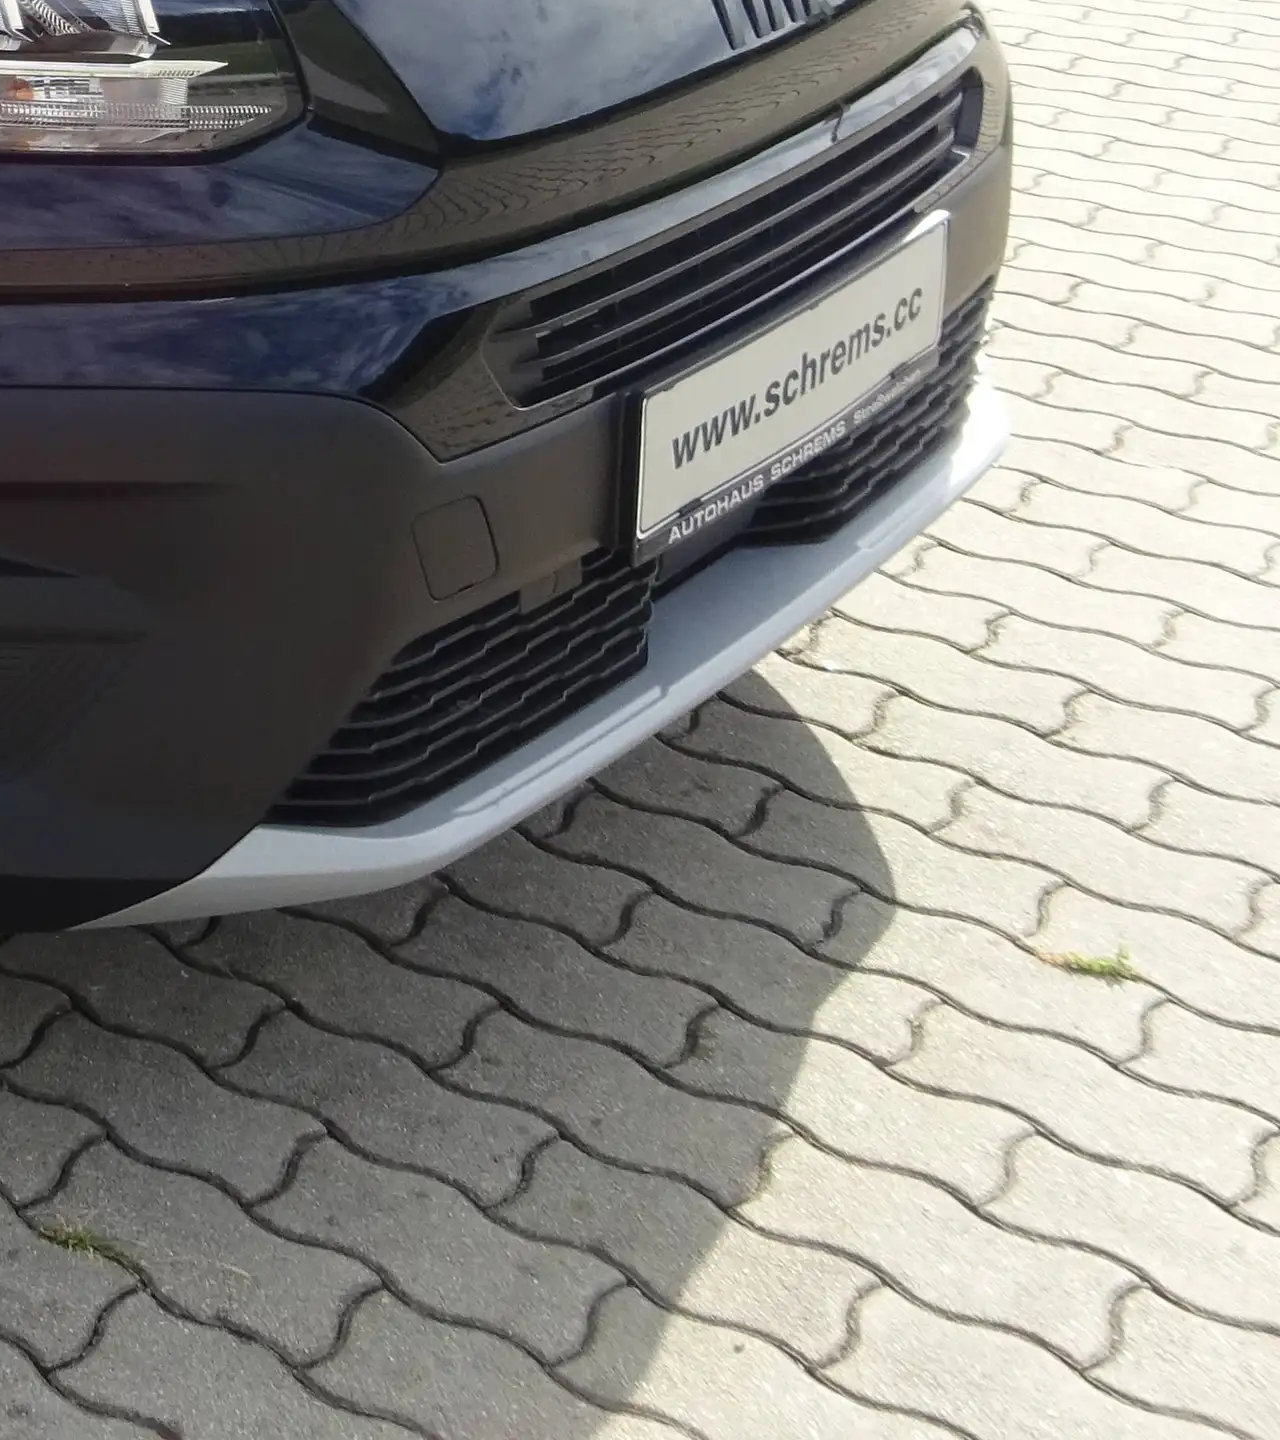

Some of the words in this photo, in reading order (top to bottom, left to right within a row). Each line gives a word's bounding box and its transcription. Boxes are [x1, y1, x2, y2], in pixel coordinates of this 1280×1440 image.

[670, 287, 923, 470] www.schrems.cc
[668, 474, 765, 545] AUTOHAUS
[770, 420, 847, 481] SCHREMS
